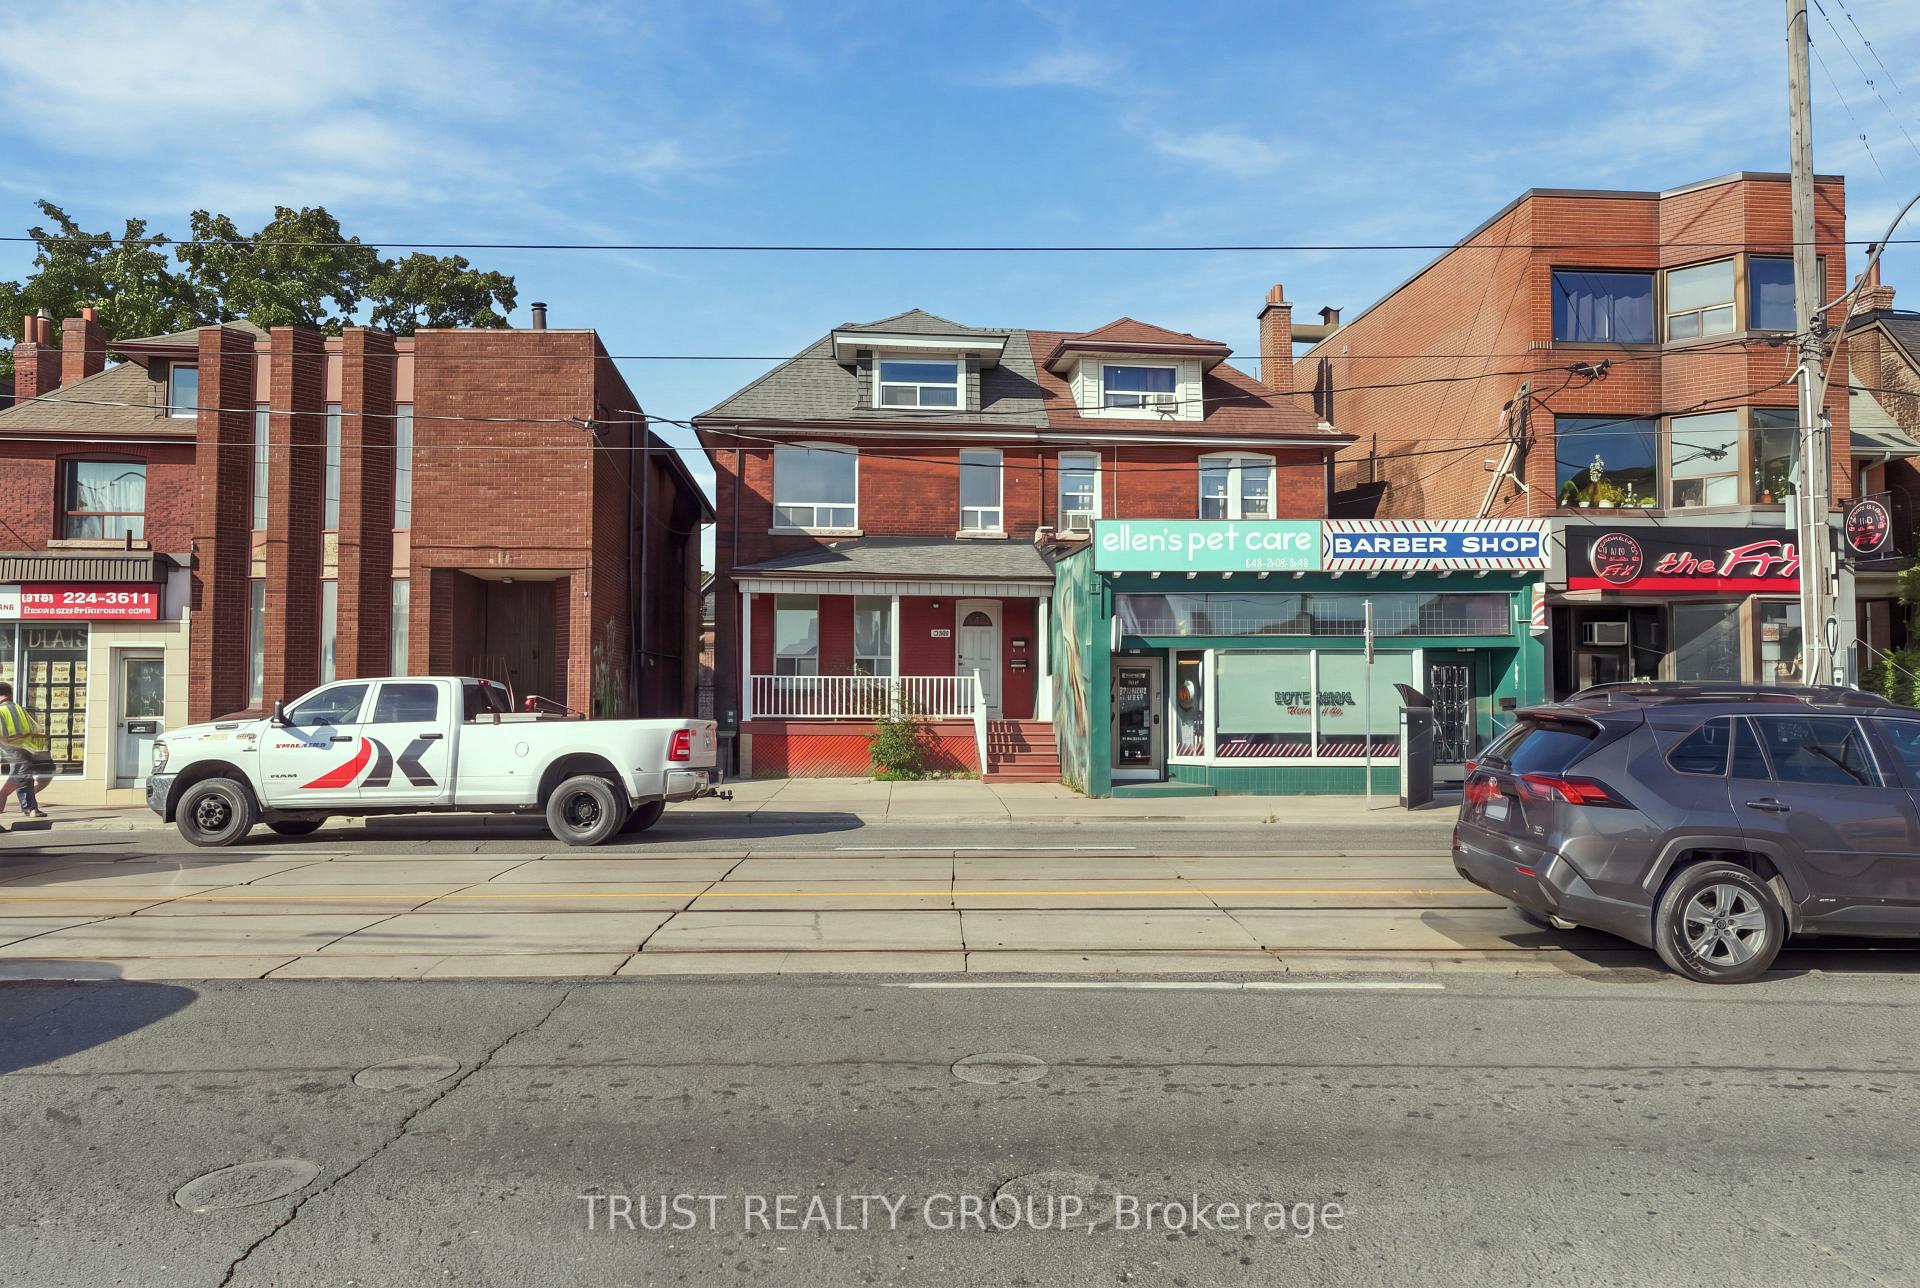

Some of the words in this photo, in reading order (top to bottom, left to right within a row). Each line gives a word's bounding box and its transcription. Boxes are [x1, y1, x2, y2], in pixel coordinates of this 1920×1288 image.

[1102, 524, 1183, 552] ellen's
[1188, 523, 1240, 561] pet
[1245, 531, 1312, 551] care
[1335, 537, 1448, 553] BARBER
[1462, 536, 1538, 553] SHOP
[1655, 551, 1717, 575] the
[63, 592, 149, 604] 224-3611
